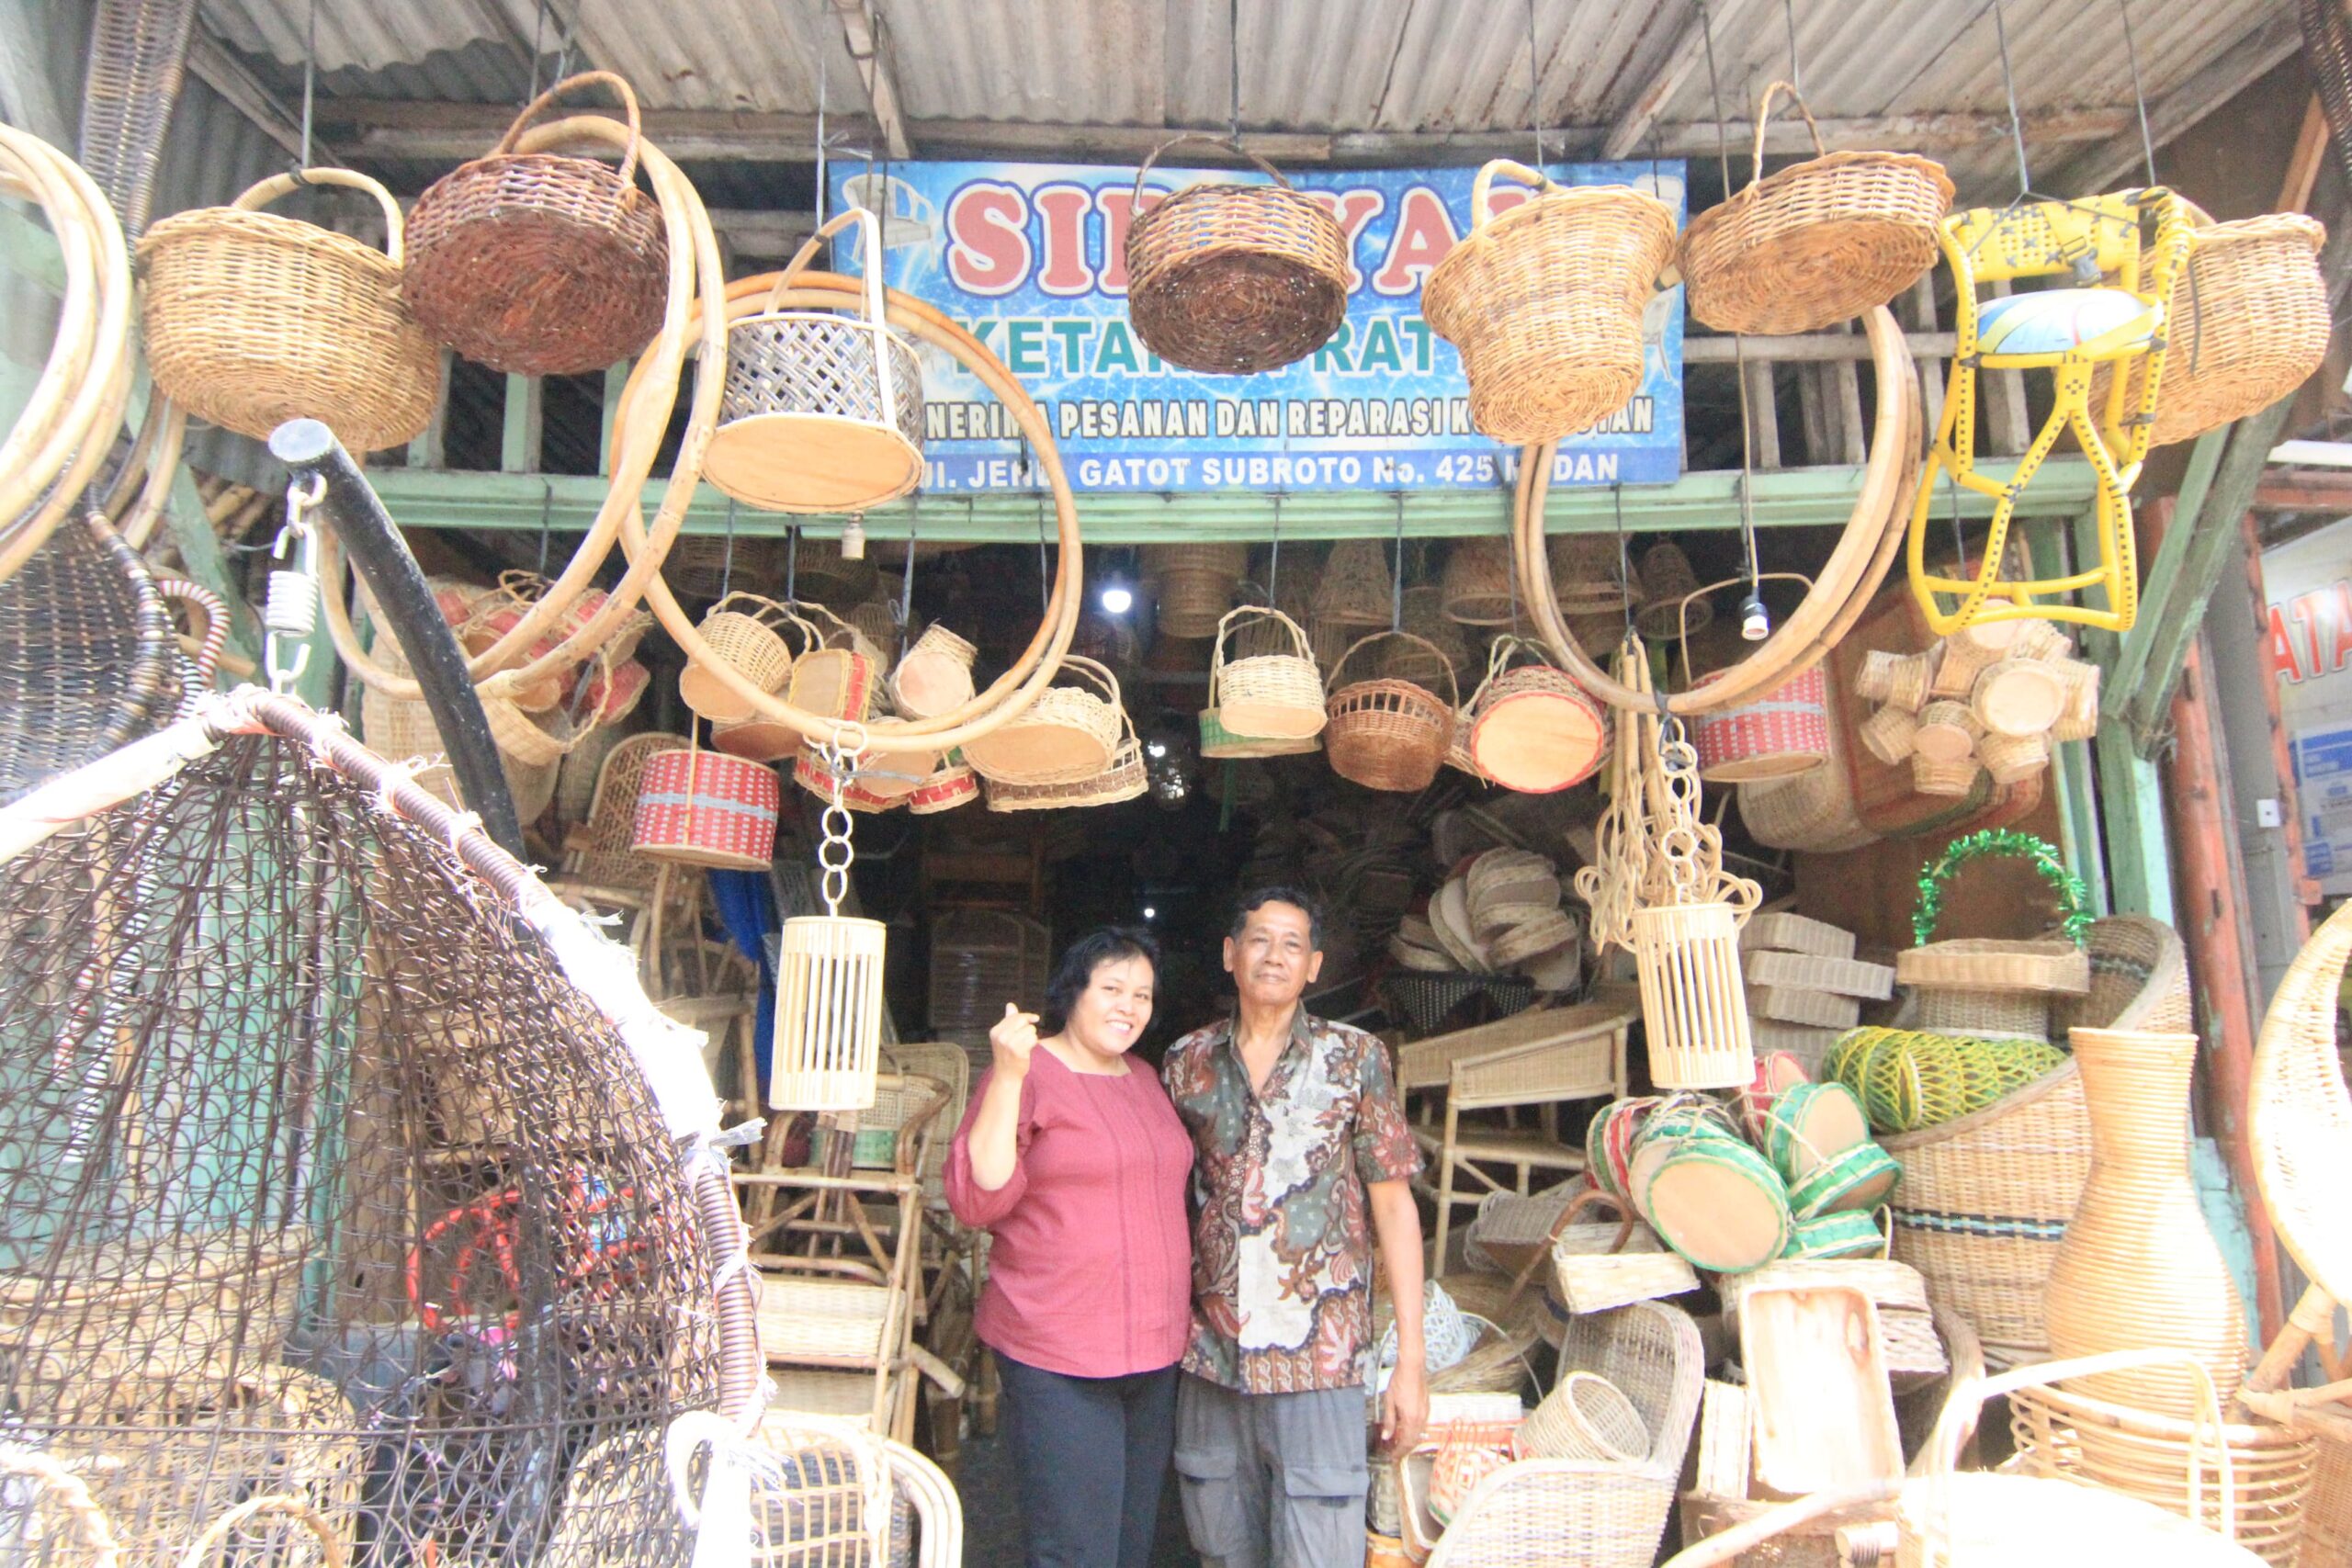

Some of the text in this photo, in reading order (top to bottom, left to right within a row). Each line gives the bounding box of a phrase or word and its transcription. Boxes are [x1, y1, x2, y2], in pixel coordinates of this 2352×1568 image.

[1059, 399, 1208, 439] PESANAN
[1216, 399, 1280, 438] DAN
[1287, 397, 1443, 437] REPARASI
[1079, 458, 1191, 487] GATOT
[1202, 457, 1362, 485] SUBROTO
[1374, 456, 1424, 484] No.
[1436, 455, 1493, 482] 425
